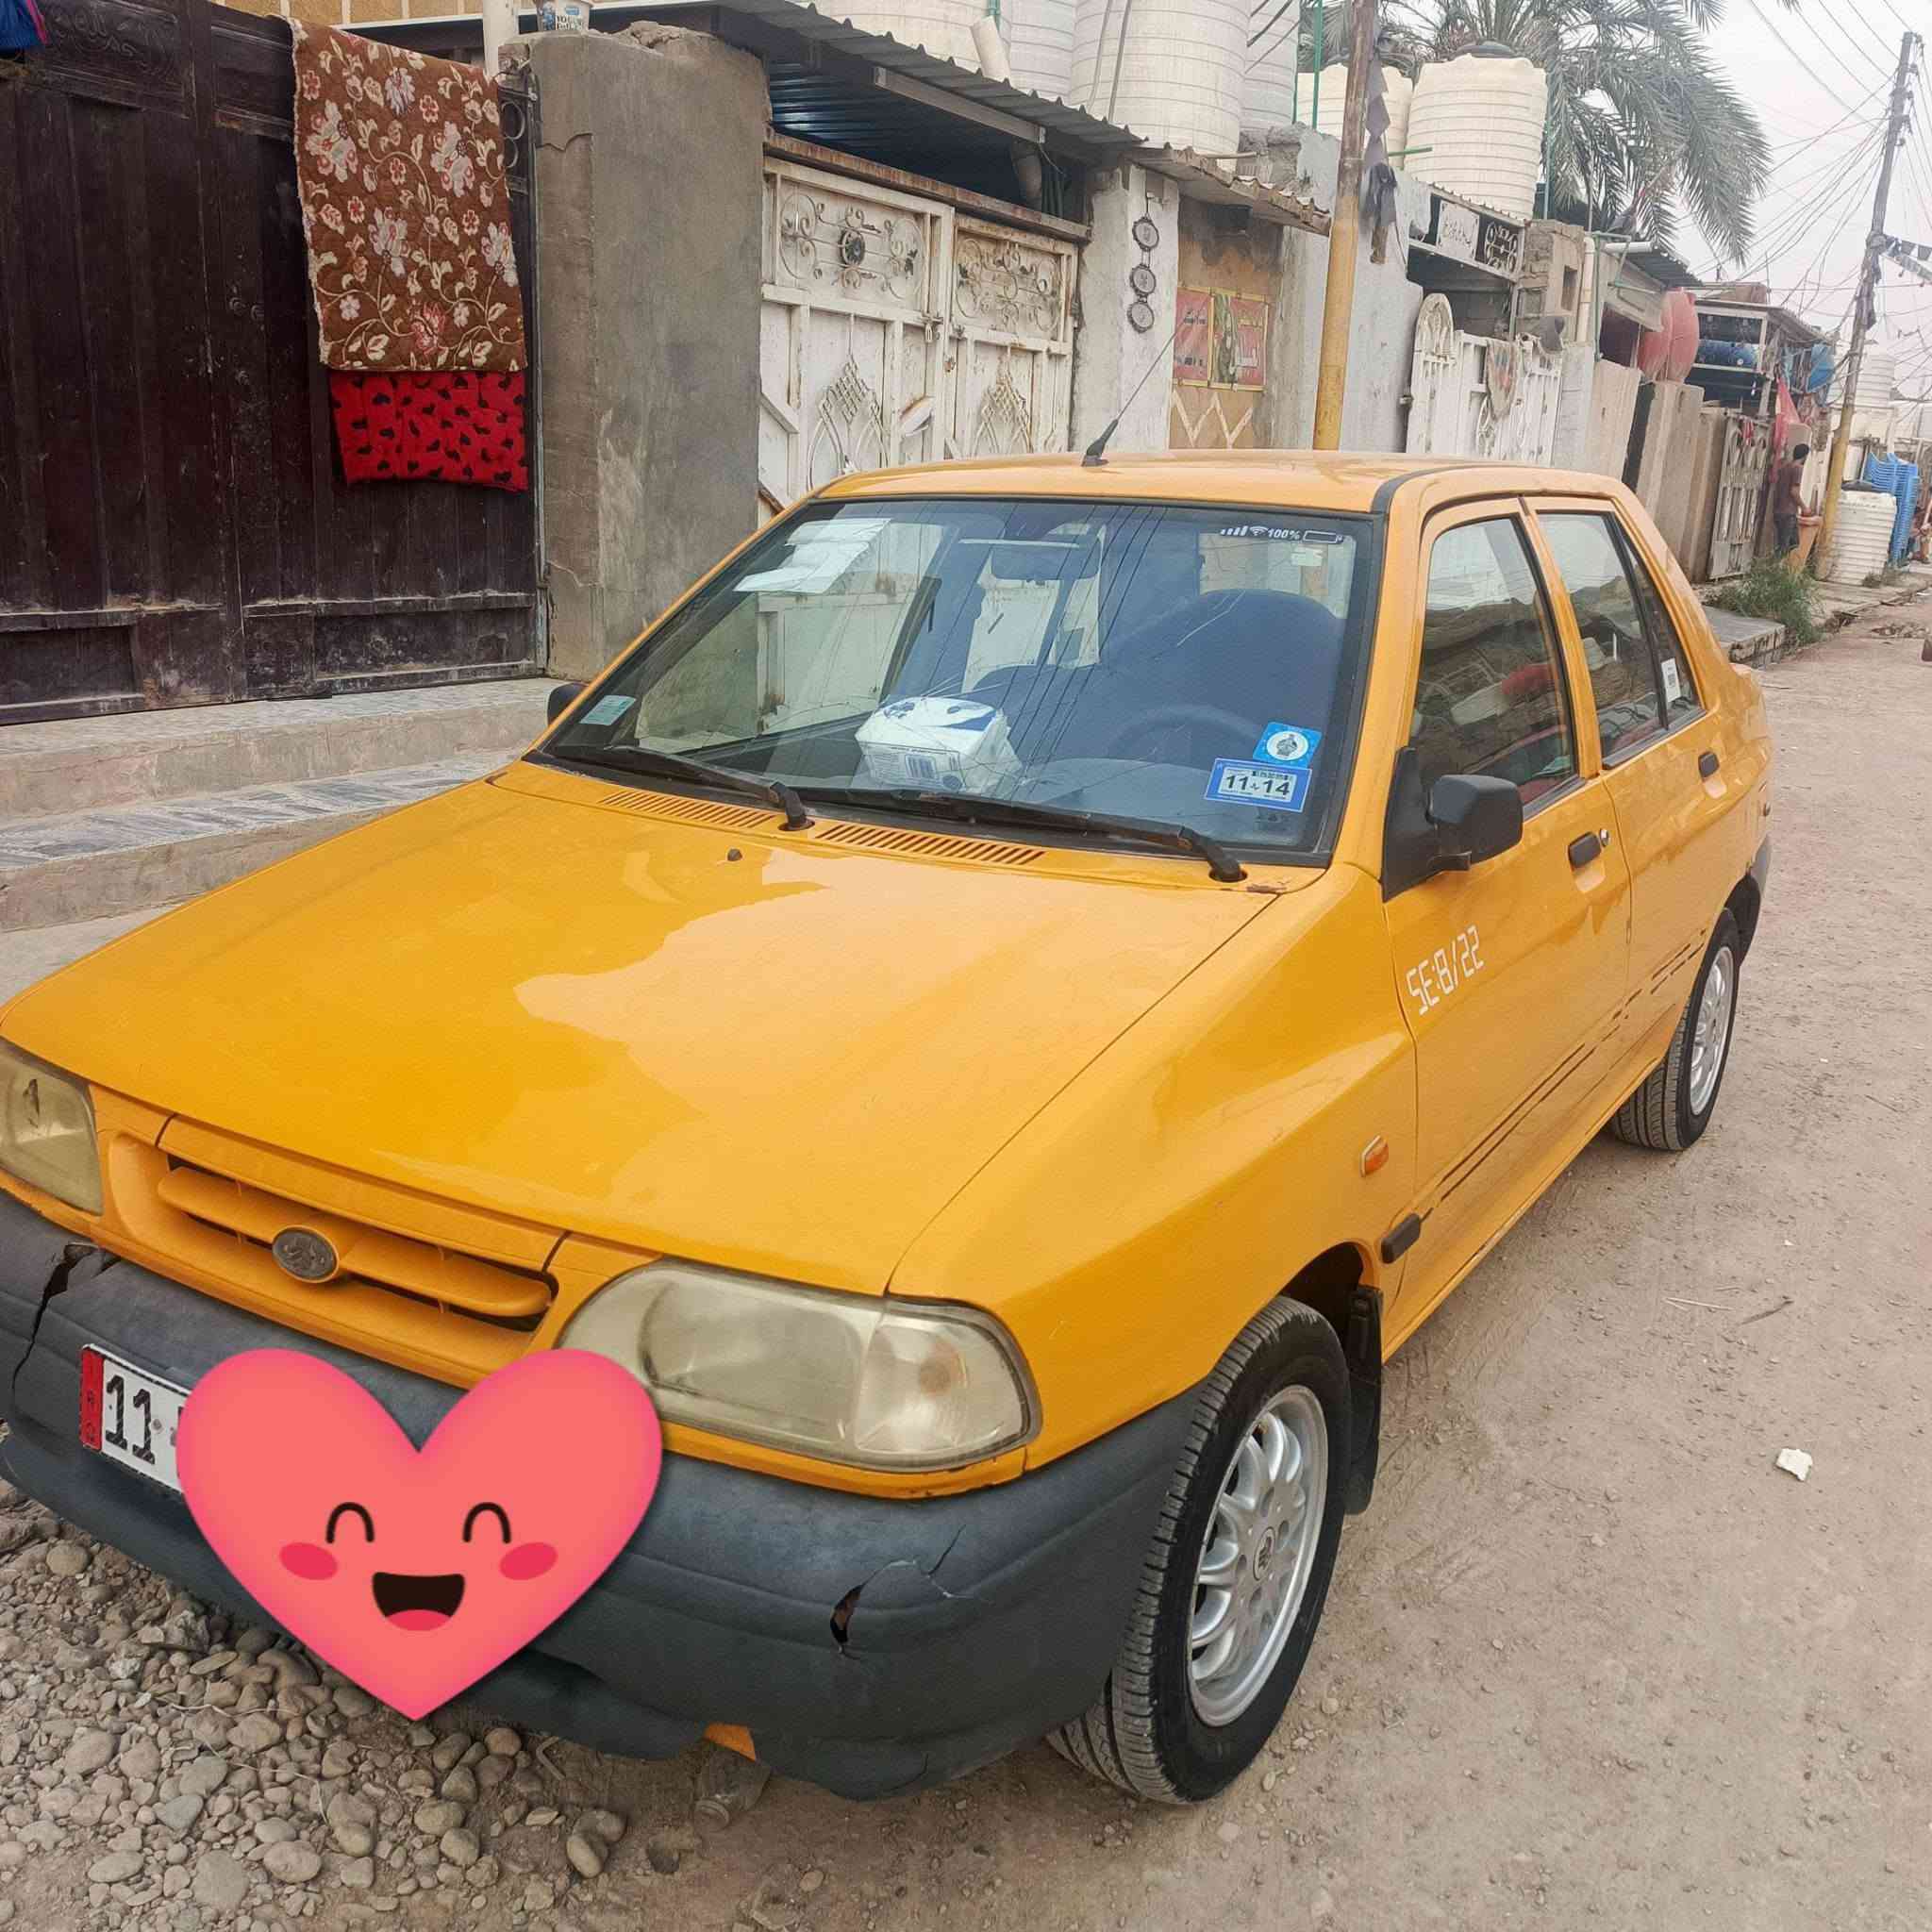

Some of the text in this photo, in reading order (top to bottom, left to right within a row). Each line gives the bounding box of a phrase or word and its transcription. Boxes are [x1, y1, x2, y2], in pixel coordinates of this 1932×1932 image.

[1268, 528, 1300, 541] 100%
[1225, 774, 1249, 791] 11
[1262, 779, 1291, 795] 14
[106, 1374, 156, 1465] 11
